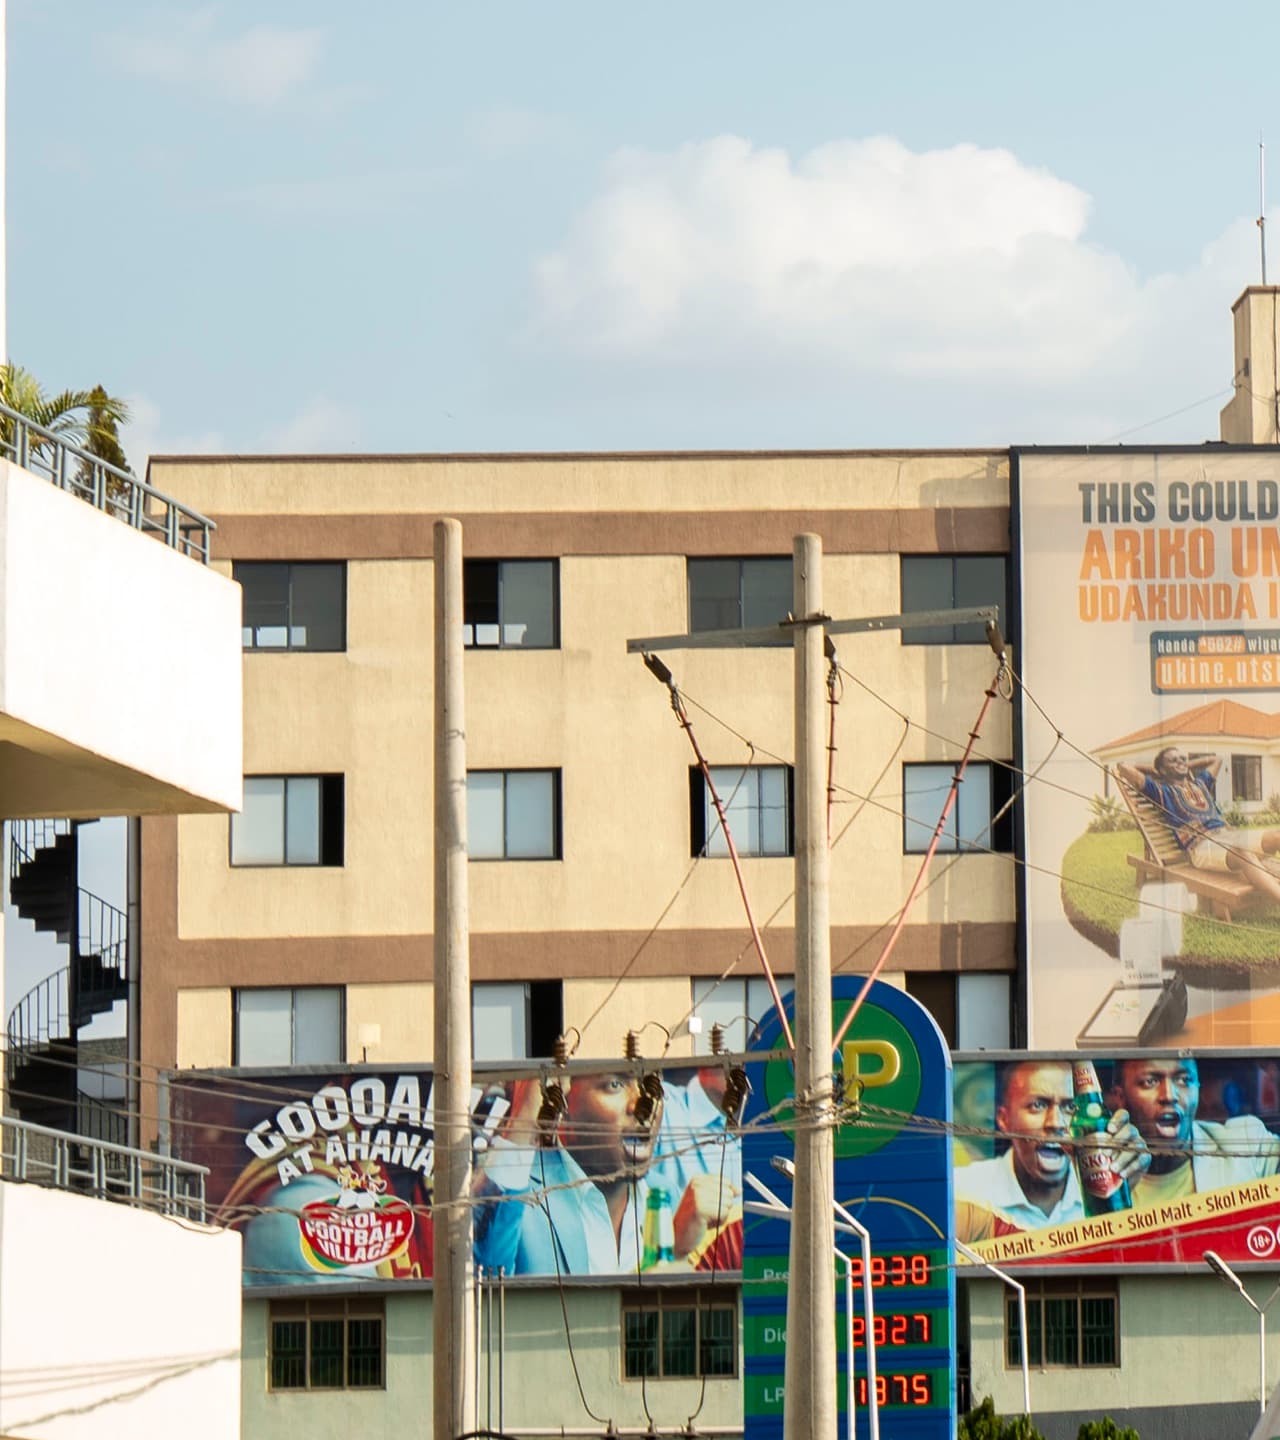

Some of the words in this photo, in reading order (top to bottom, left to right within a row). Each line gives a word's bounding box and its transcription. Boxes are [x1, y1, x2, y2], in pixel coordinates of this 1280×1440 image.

[1078, 482, 1156, 524] THIS
[1168, 480, 1279, 523] COULD
[1079, 527, 1216, 581] ARIKO
[1078, 581, 1258, 623] UDAKUNDA
[276, 1144, 316, 1187] AT
[305, 1219, 406, 1247] FOOTBALL
[1003, 1236, 1036, 1259] Malt
[1048, 1229, 1079, 1249] Skol
[1082, 1222, 1115, 1242] Malt
[1127, 1209, 1158, 1231] Skol
[1161, 1203, 1193, 1224] Malt
[1205, 1190, 1237, 1213] Skol
[1239, 1183, 1271, 1205] Malt
[1251, 1232, 1271, 1249] 18+
[316, 1237, 396, 1262] VILLAGE
